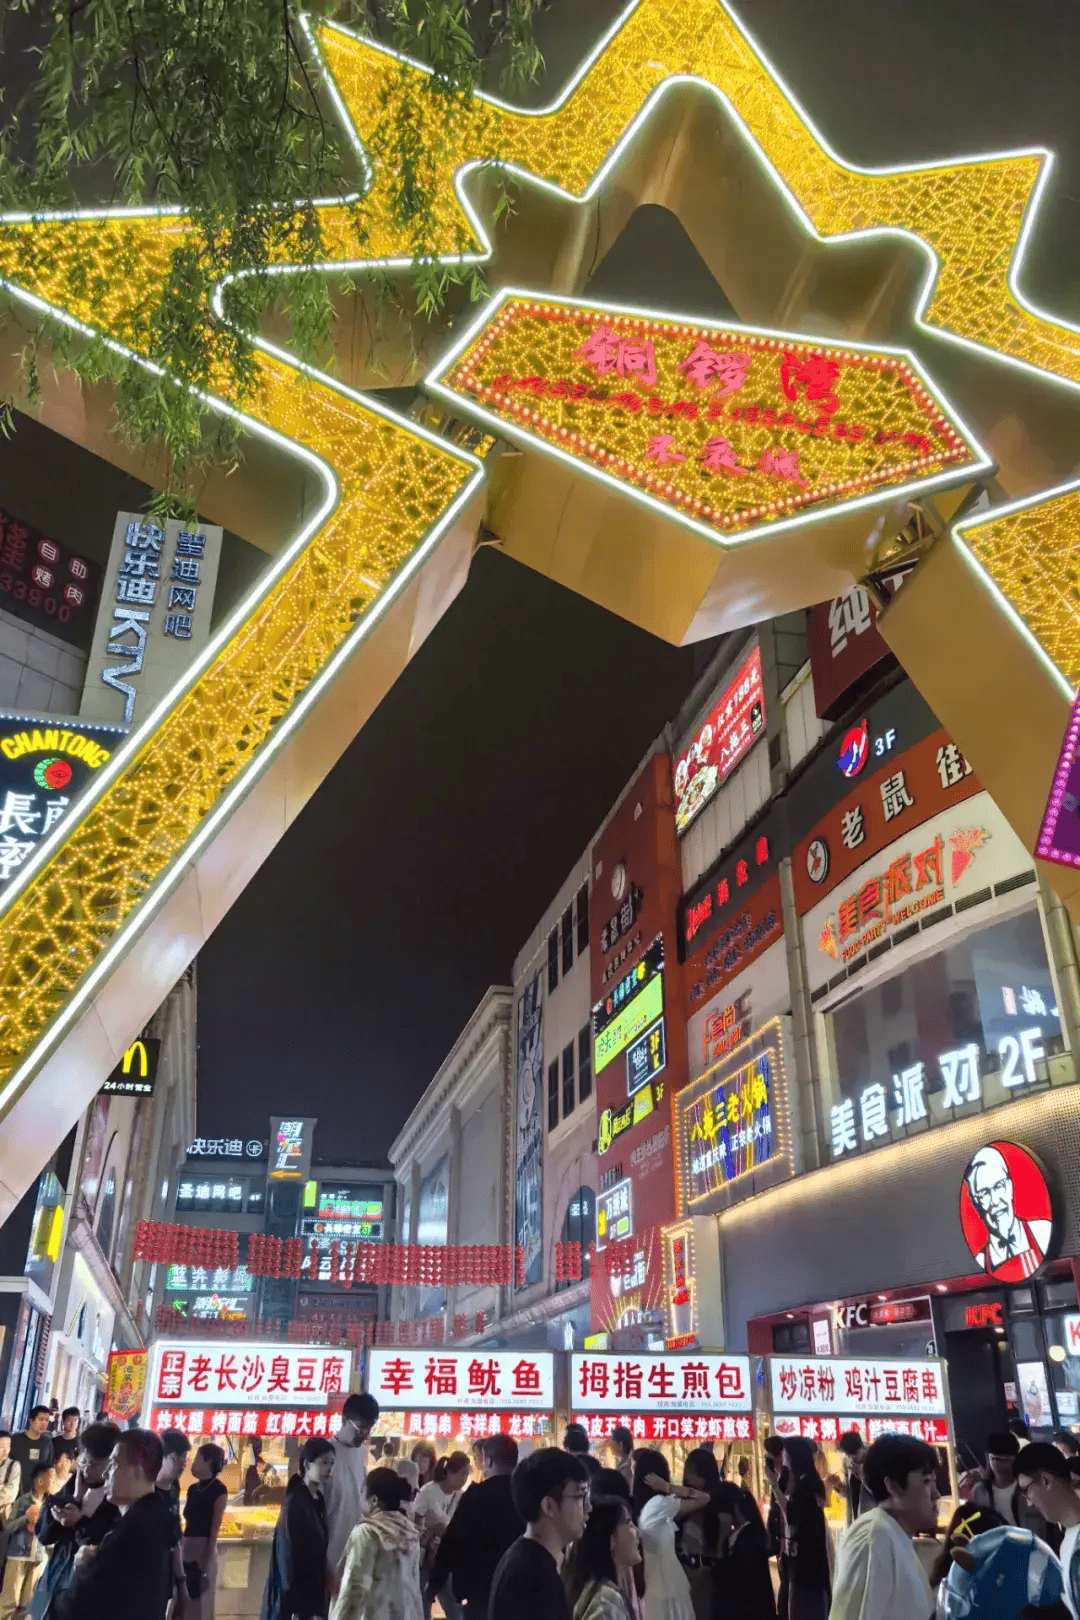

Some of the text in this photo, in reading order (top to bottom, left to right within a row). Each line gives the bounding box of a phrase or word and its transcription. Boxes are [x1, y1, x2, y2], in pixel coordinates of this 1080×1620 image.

[1, 729, 110, 769] CHANTONG
[874, 727, 897, 757] 3F
[837, 834, 944, 944] 美食派对
[892, 889, 945, 924] WELCOME
[104, 1080, 152, 1093] 24小时营业
[830, 1027, 1048, 1157] 美食派对 2F
[186, 1138, 243, 1156] 快乐迪
[178, 1183, 242, 1200] 圣迪网吧
[832, 1303, 867, 1329] KFC
[965, 1303, 1003, 1327] KFC
[162, 1354, 183, 1396] 正宗
[187, 1353, 345, 1394] 老长沙臭豆腐
[380, 1357, 544, 1396] 幸福鱿鱼
[578, 1360, 745, 1400] 拇指生煎包
[778, 1364, 939, 1404] 炒凉粉 鸡汁豆腐串
[156, 1410, 203, 1433] 炸火腿
[210, 1411, 259, 1434] 烤面筋
[652, 1416, 751, 1438] 开口笑龙虾煎饺
